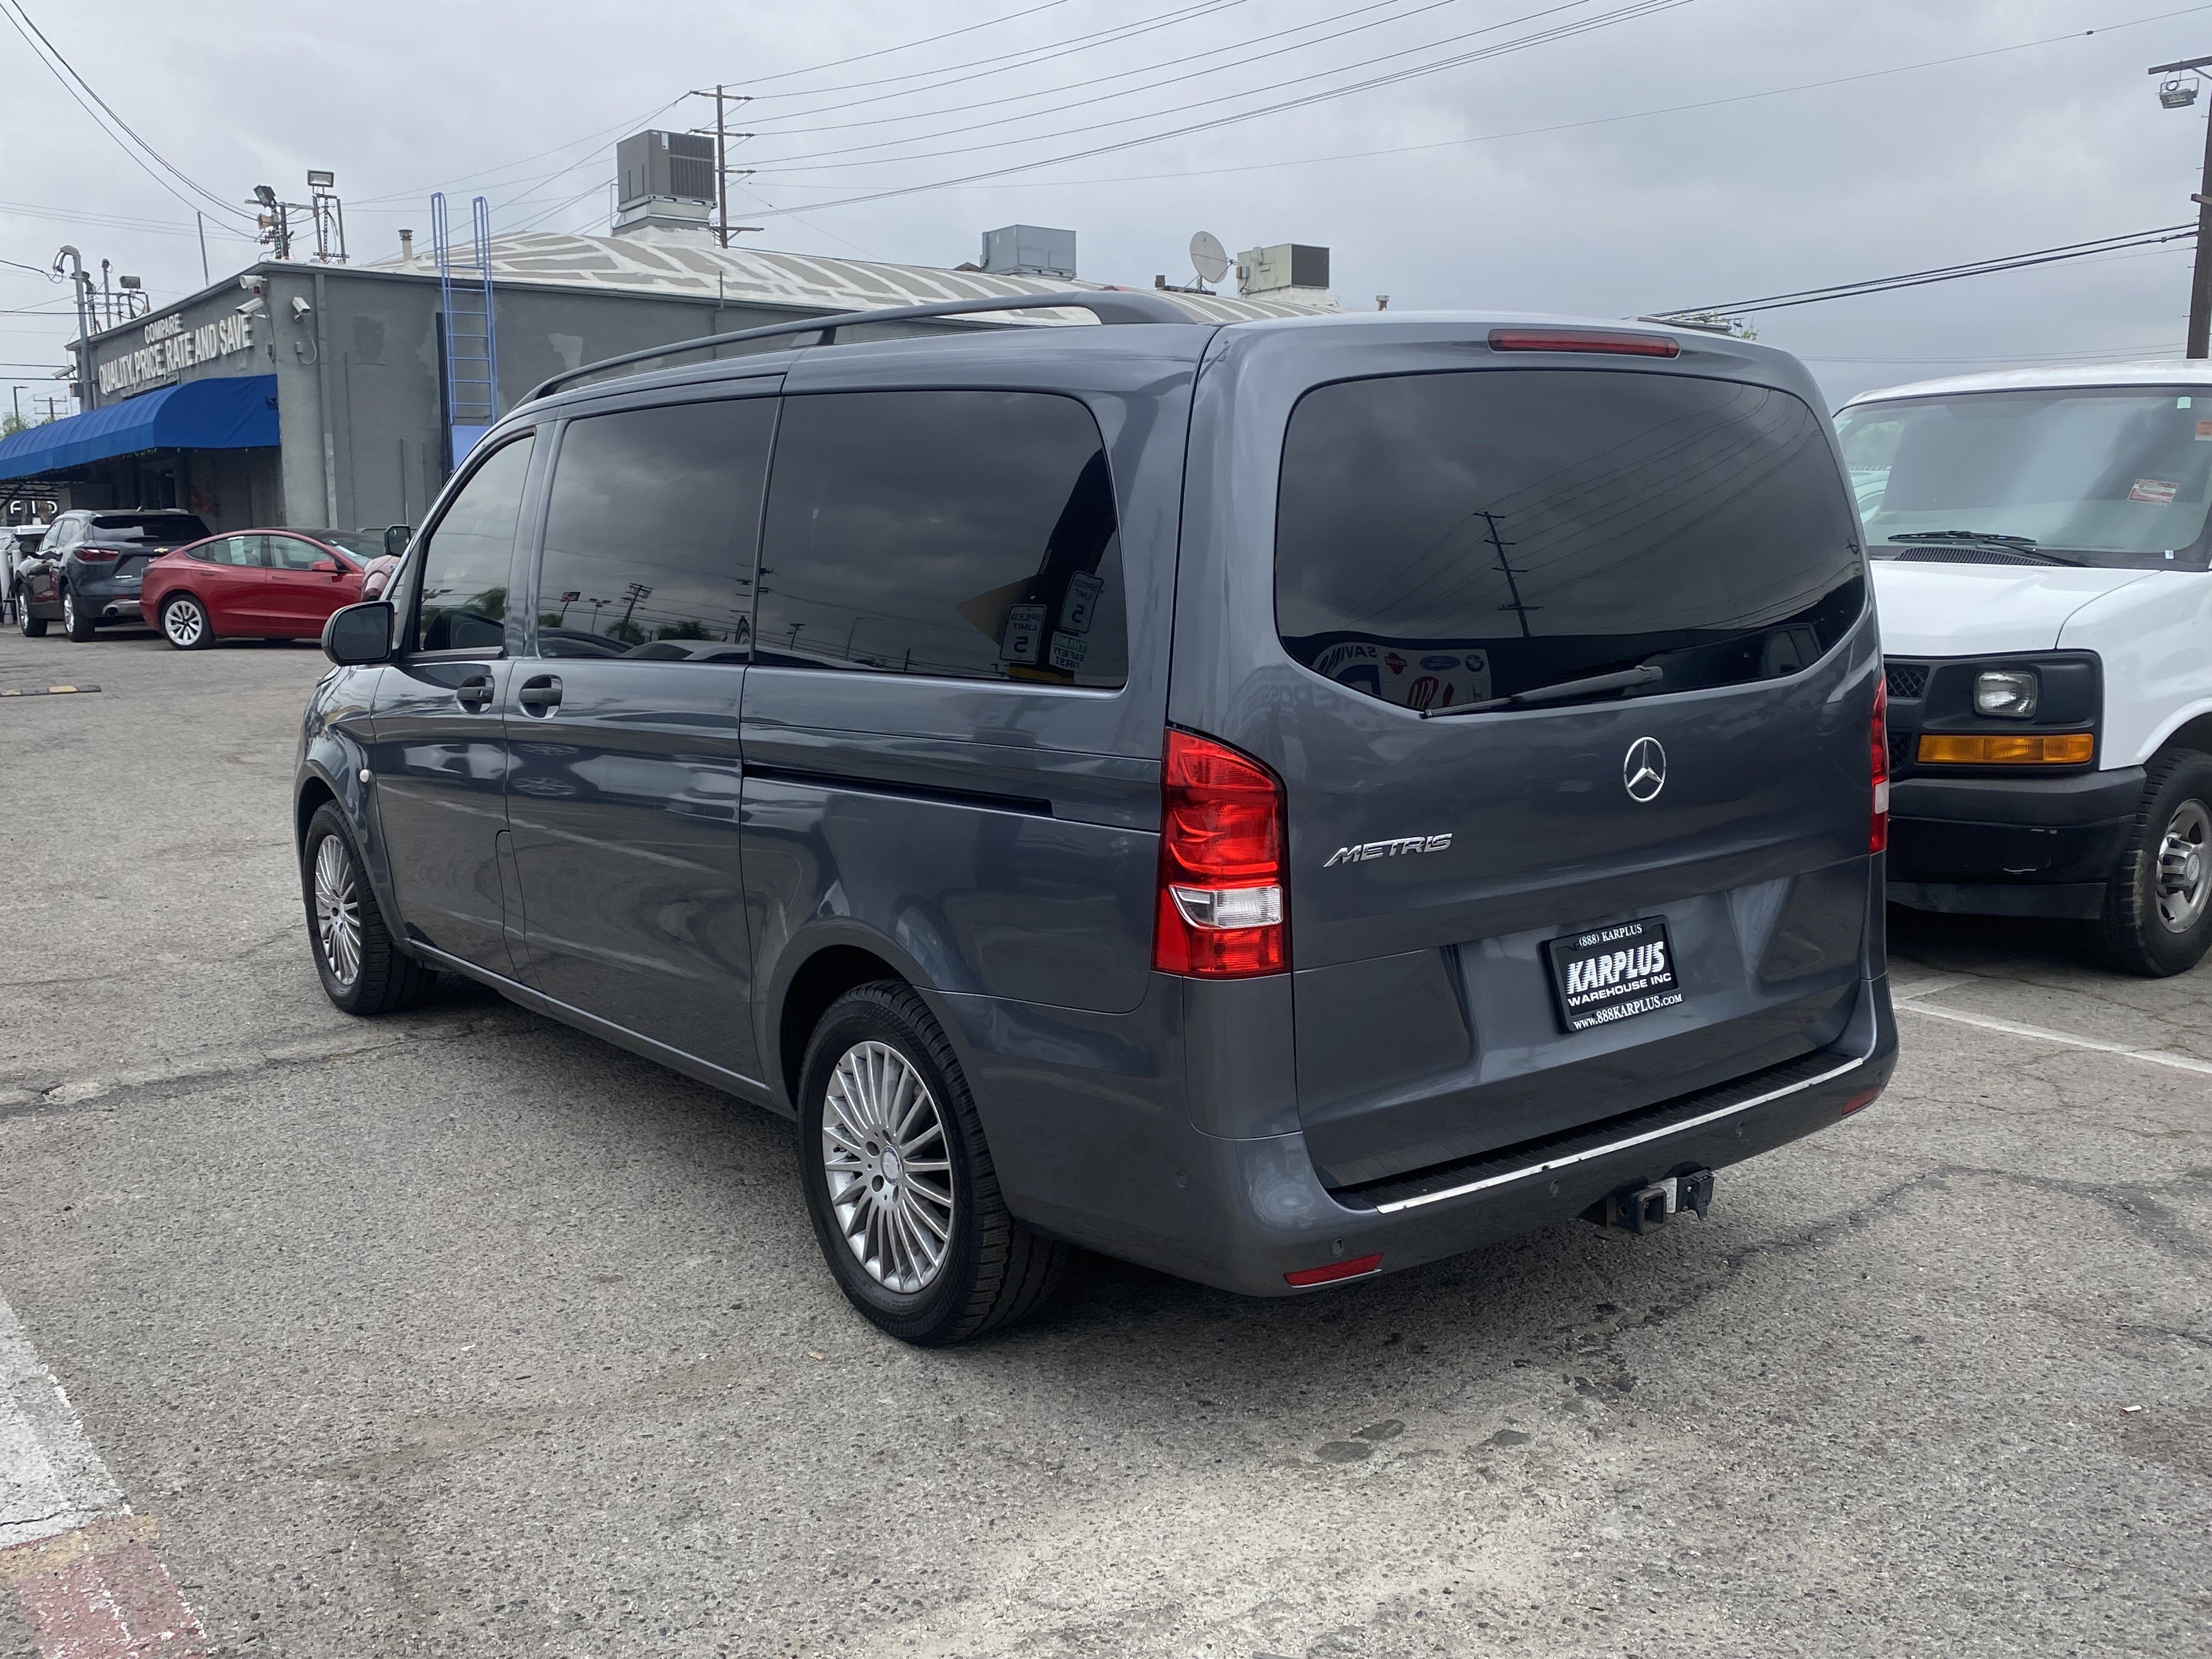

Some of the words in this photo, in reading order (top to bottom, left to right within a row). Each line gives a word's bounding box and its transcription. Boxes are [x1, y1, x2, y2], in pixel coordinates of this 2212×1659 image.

[144, 313, 183, 344] COMPARE
[165, 332, 193, 373] RATE
[195, 324, 218, 363] AND
[219, 314, 254, 356] SAVE
[1323, 833, 1453, 867] METRIS
[1579, 933, 1600, 947] (888)
[1601, 923, 1643, 942] KARPLUS
[1566, 941, 1665, 995] KARPLUS
[1567, 978, 1648, 1007] WAREHOUSE
[1650, 973, 1672, 986] INC
